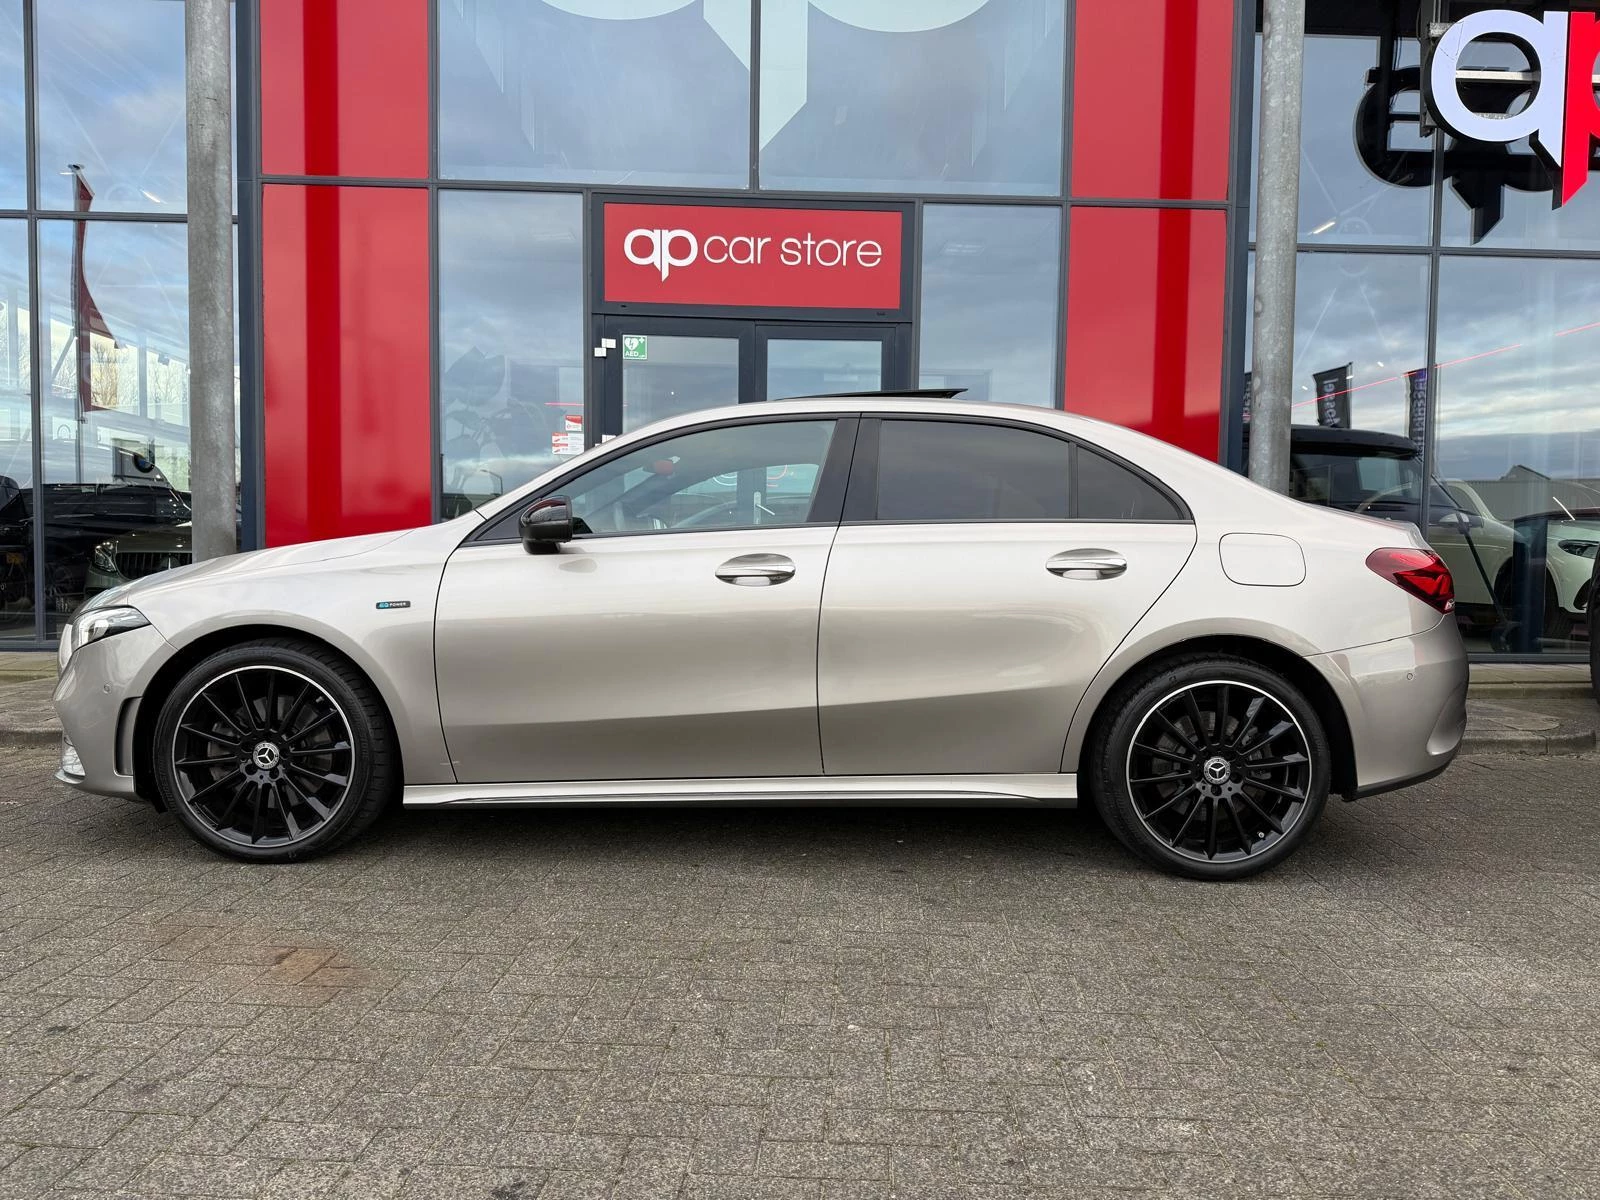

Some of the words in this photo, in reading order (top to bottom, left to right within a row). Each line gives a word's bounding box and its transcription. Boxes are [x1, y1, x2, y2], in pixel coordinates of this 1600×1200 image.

[1431, 9, 1600, 208] a
[703, 235, 772, 264] car
[780, 232, 882, 268] store
